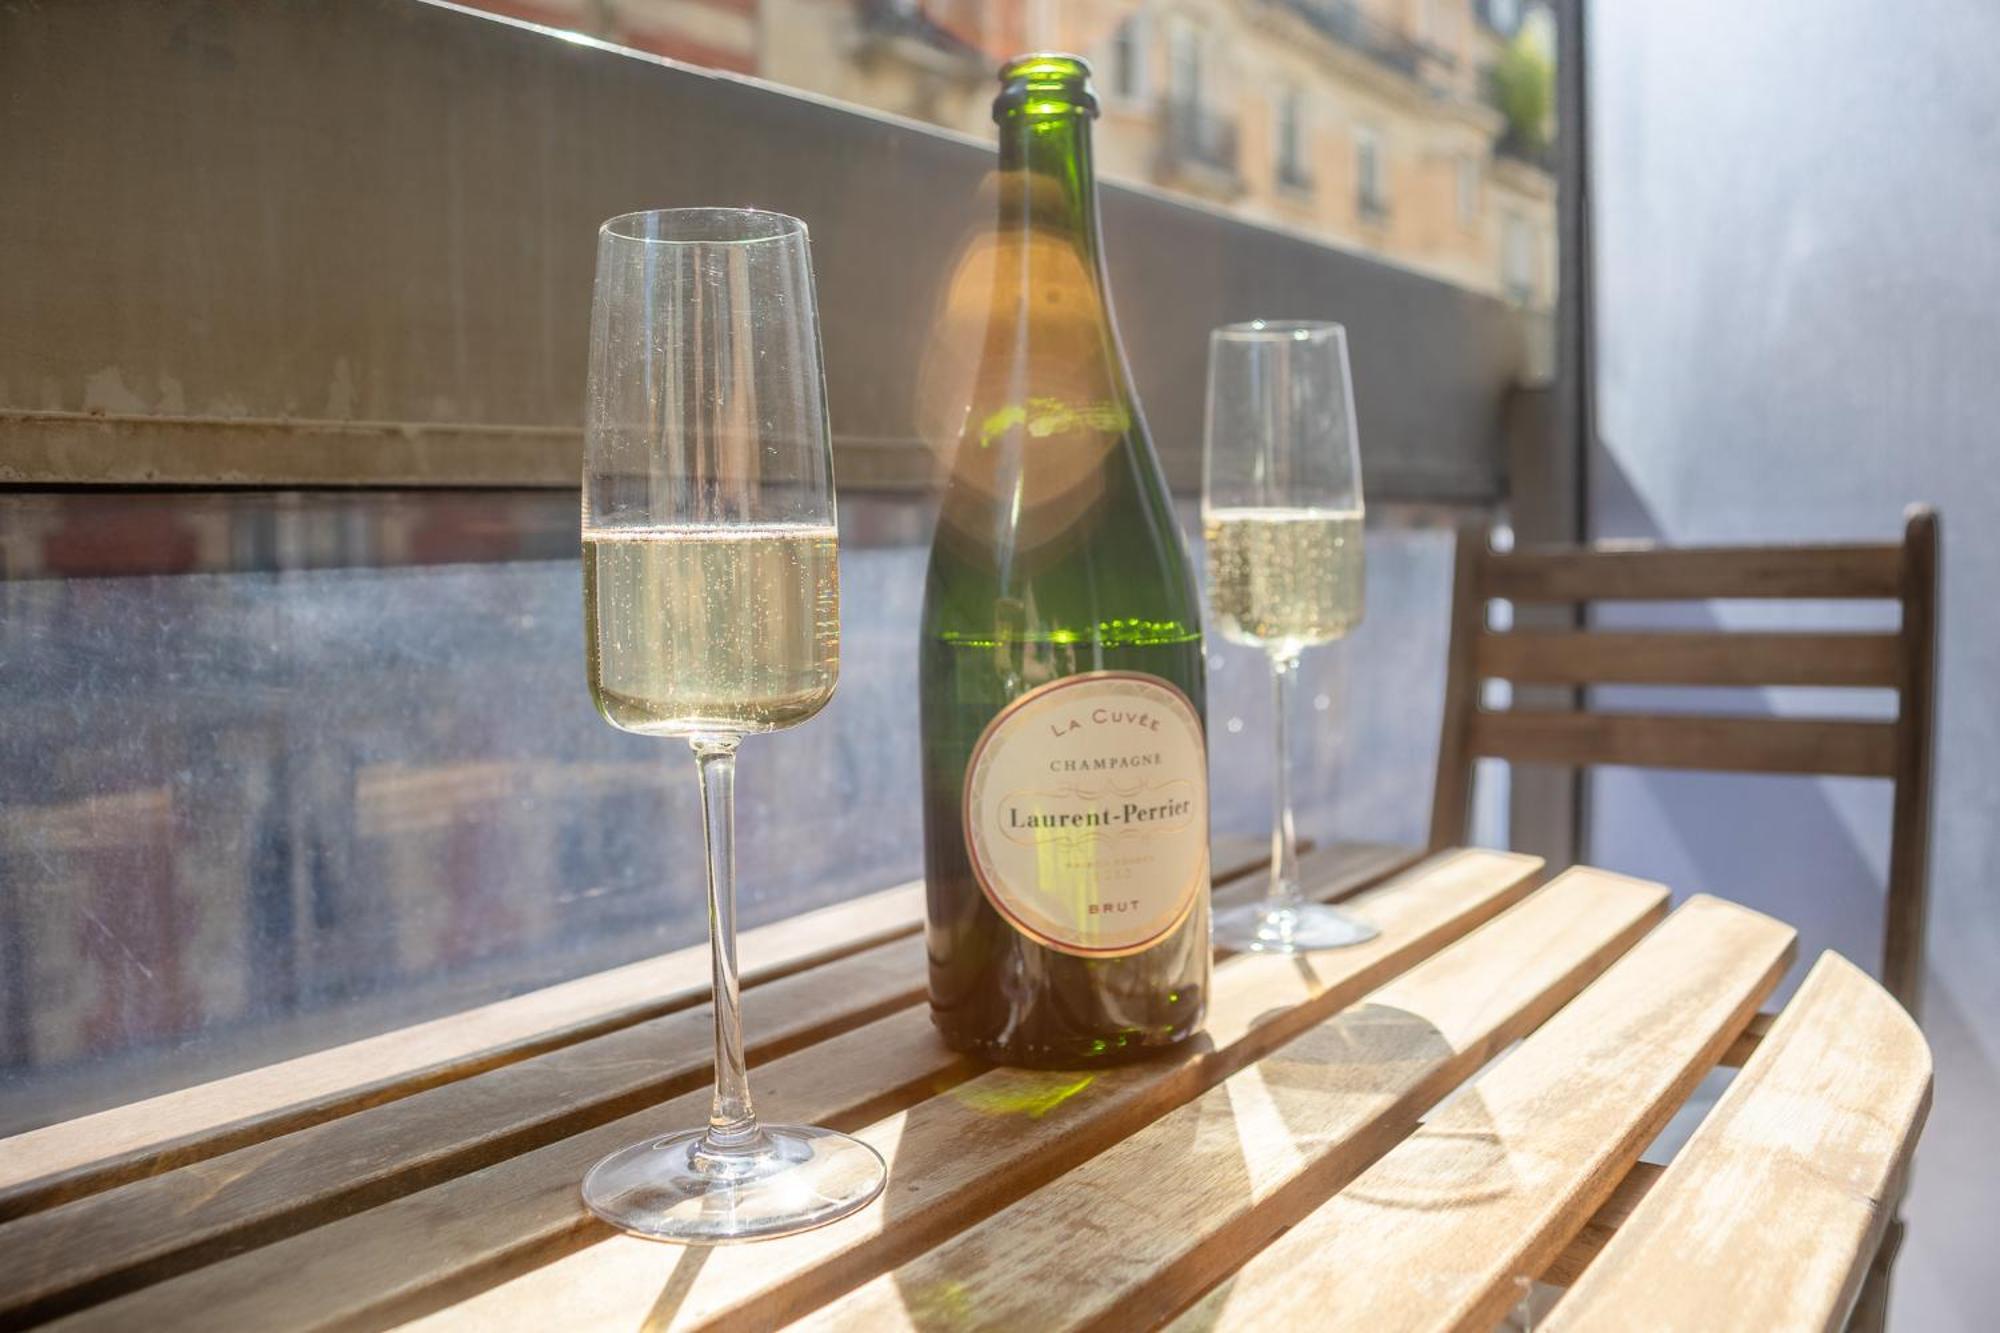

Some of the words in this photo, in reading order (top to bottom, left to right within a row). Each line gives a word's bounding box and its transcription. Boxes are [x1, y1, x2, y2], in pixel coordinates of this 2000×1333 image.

[1051, 720, 1081, 737] LA
[1050, 753, 1162, 772] CHAMPAGNE
[1010, 799, 1190, 829] Laurent-Perrier
[1088, 900, 1139, 915] BRUT
